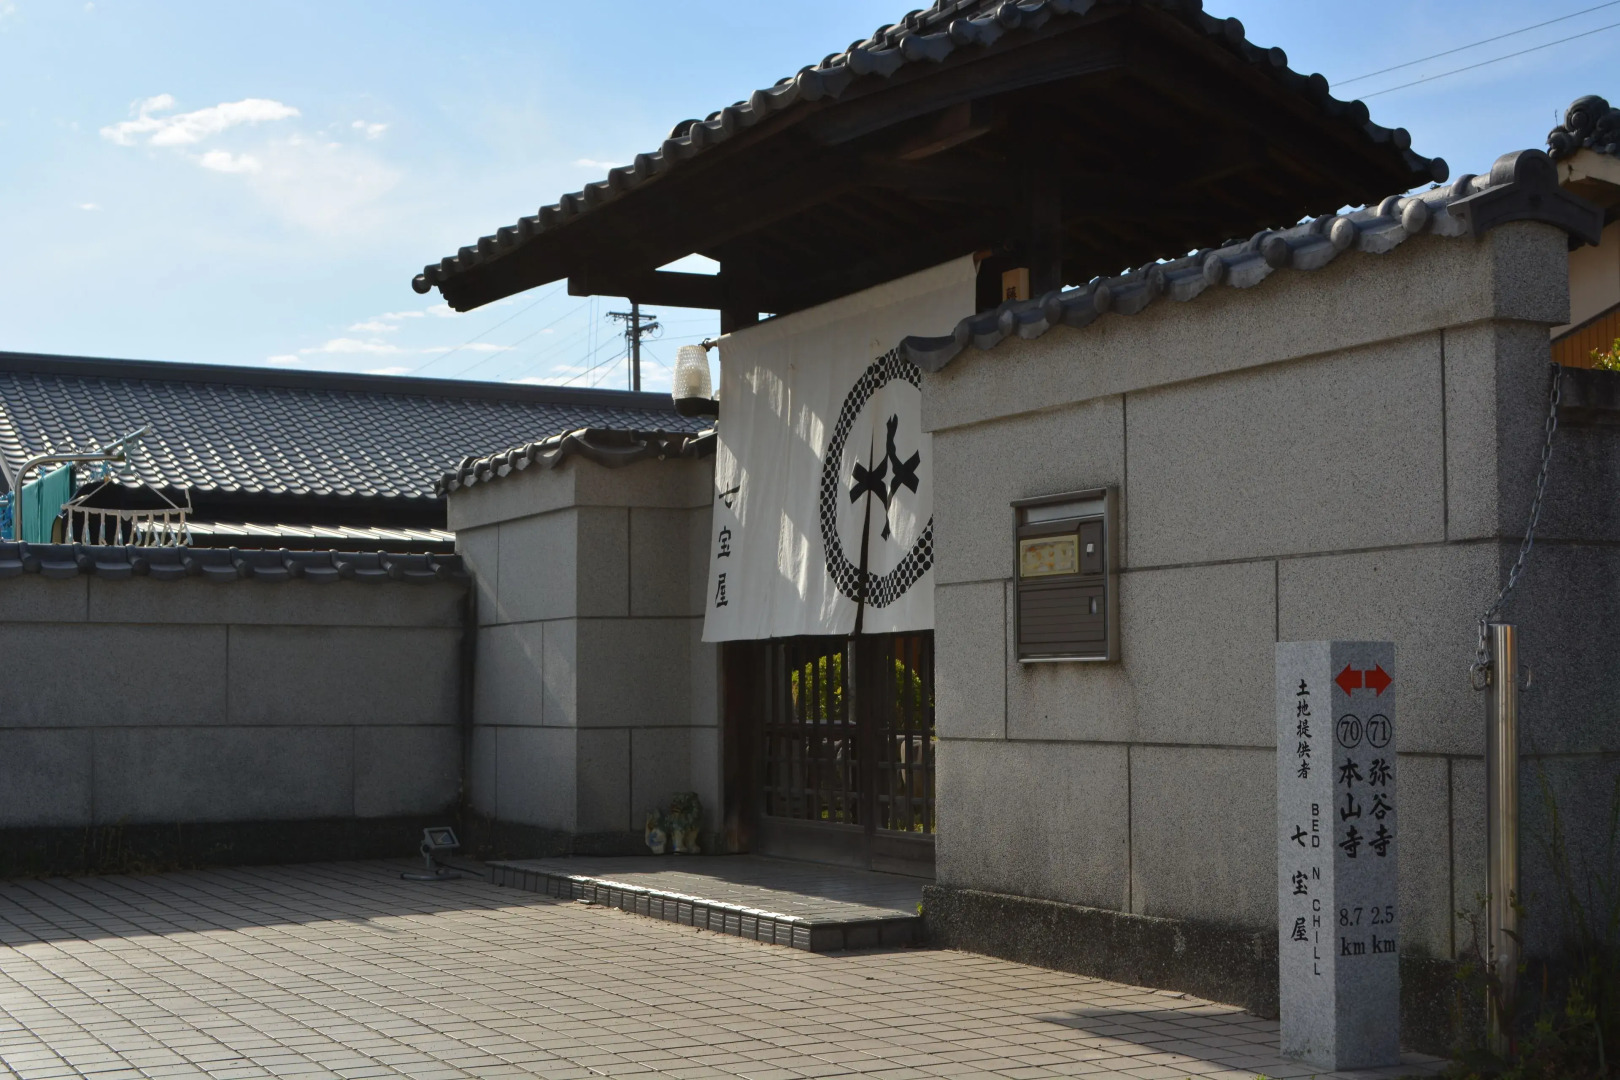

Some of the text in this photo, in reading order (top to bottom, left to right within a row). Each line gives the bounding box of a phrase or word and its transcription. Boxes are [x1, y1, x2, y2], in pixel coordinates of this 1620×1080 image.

[715, 481, 740, 608] 七宝屋
[1296, 679, 1313, 779] 土地提供者
[1339, 719, 1361, 744] 70
[1369, 719, 1389, 744] 71
[1338, 758, 1364, 859] 本山寺
[1368, 758, 1393, 858] 弥谷寺
[1290, 825, 1309, 942] 七宝屋
[1311, 803, 1321, 976] BED N CHILL
[1339, 907, 1365, 956] 8.7 km
[1371, 906, 1396, 954] 2.5 km
